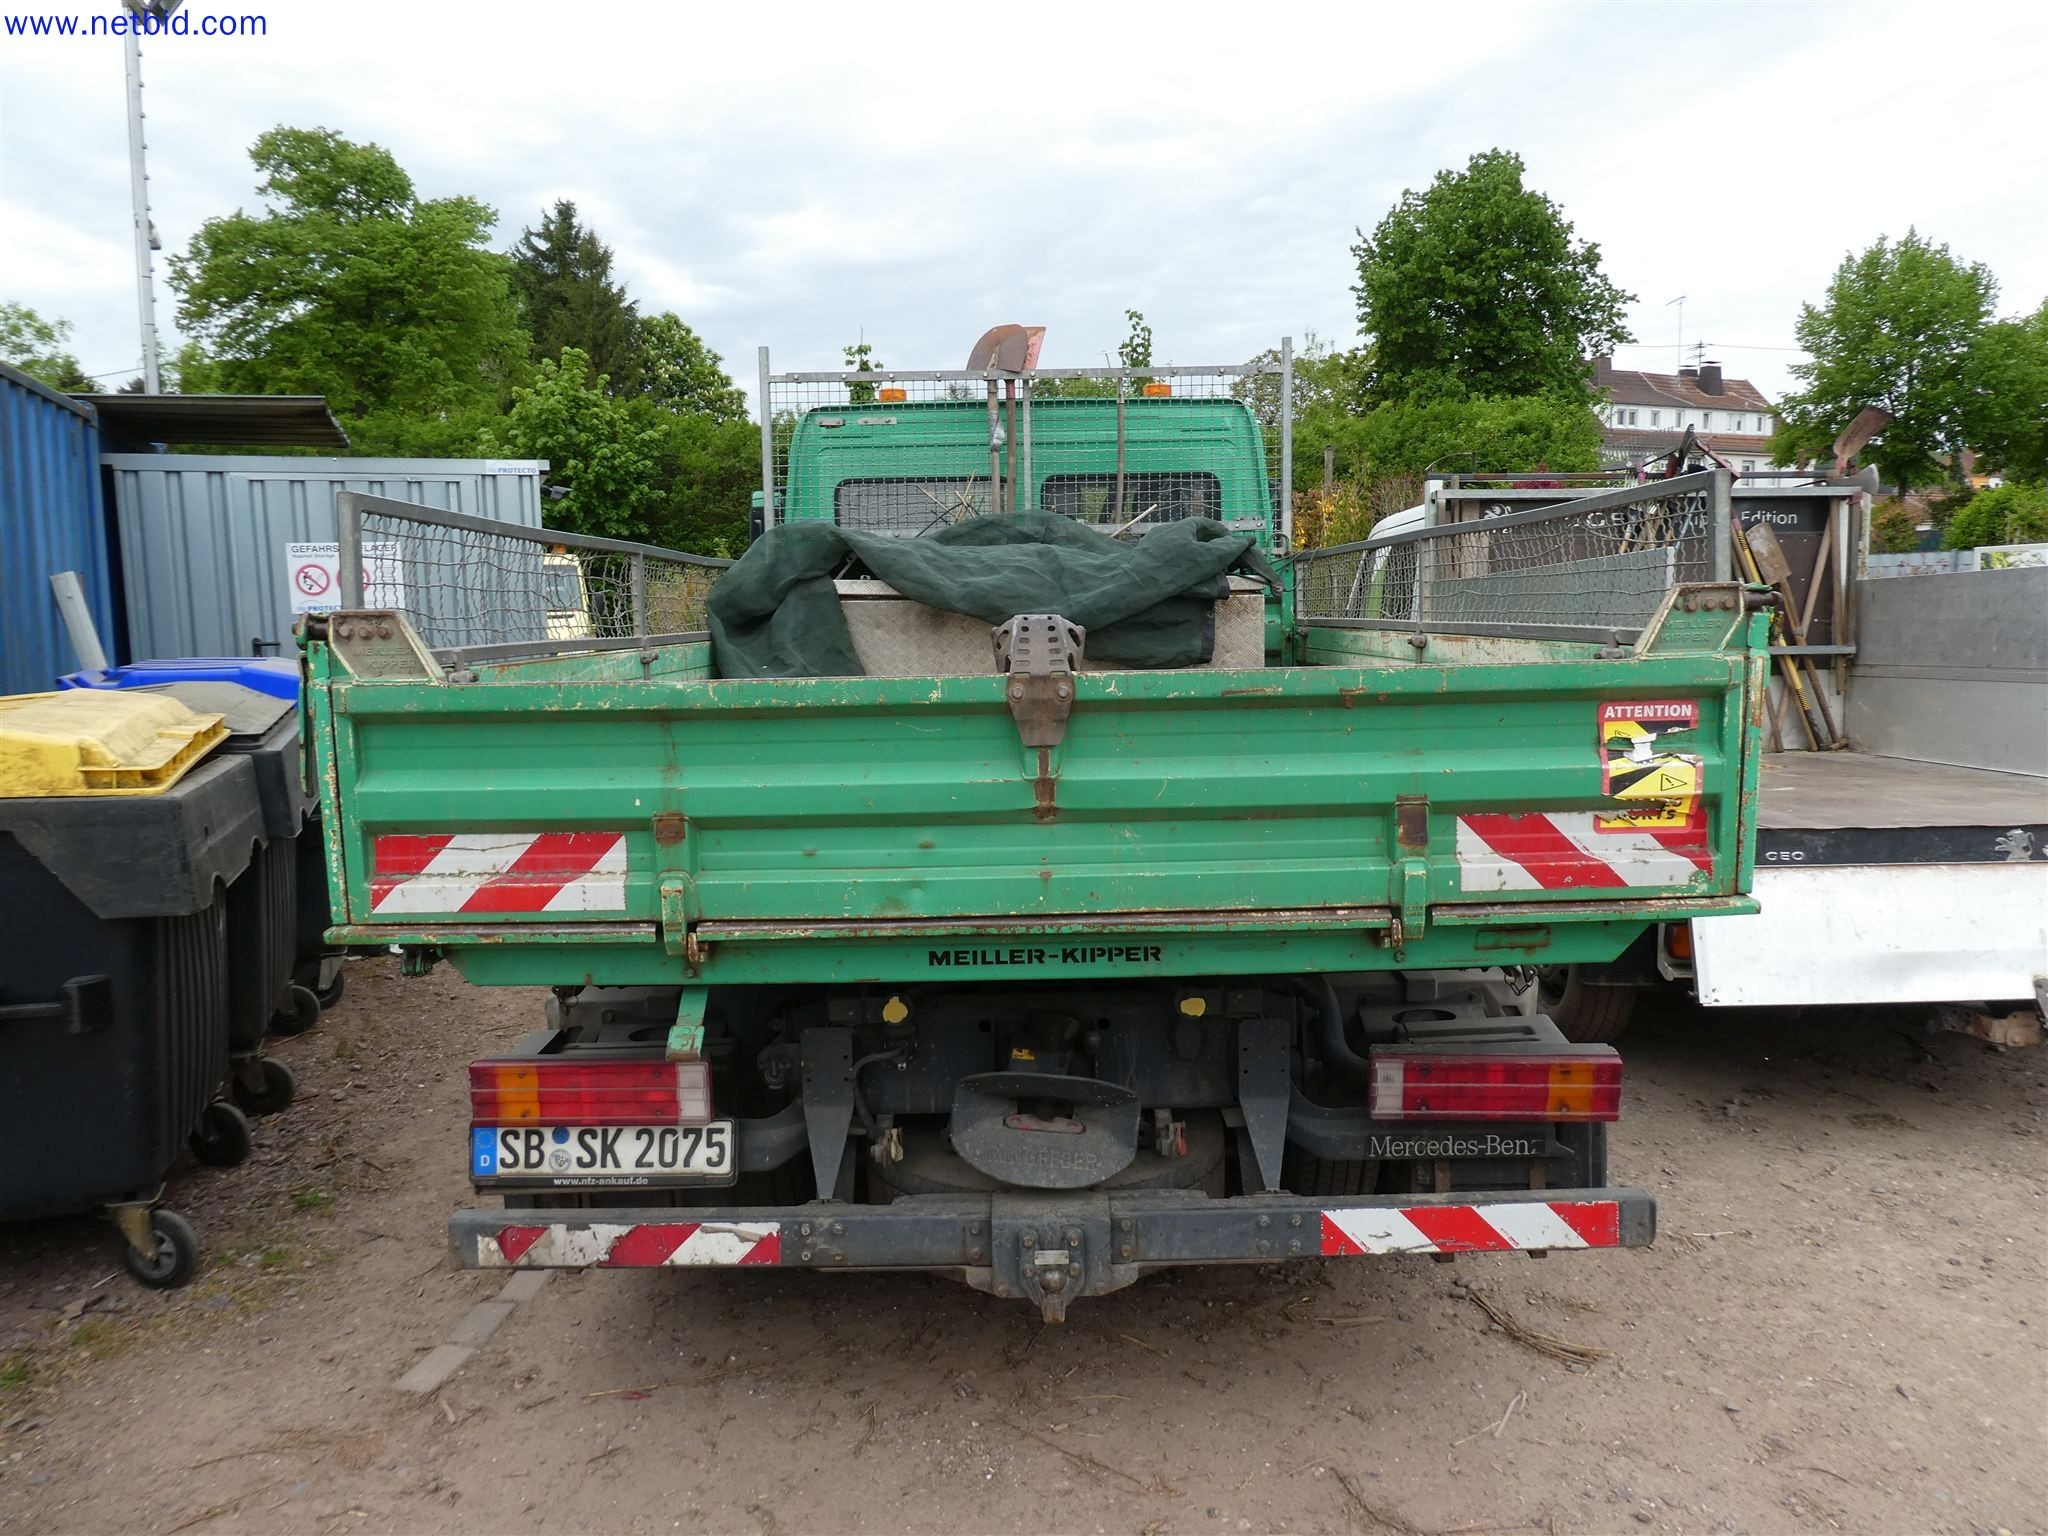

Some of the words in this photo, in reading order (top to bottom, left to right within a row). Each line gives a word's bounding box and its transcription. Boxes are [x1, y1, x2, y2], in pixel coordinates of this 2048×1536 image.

[1741, 510, 1798, 525] Edition
[1604, 704, 1692, 718] ATTENTION
[928, 946, 1162, 966] MEILLER-KIPPER
[500, 1129, 545, 1168] SB
[576, 1128, 624, 1168] SK
[634, 1127, 726, 1168] 2075
[480, 1154, 490, 1167] D
[553, 1177, 649, 1185] www.nfz-ankauf.de
